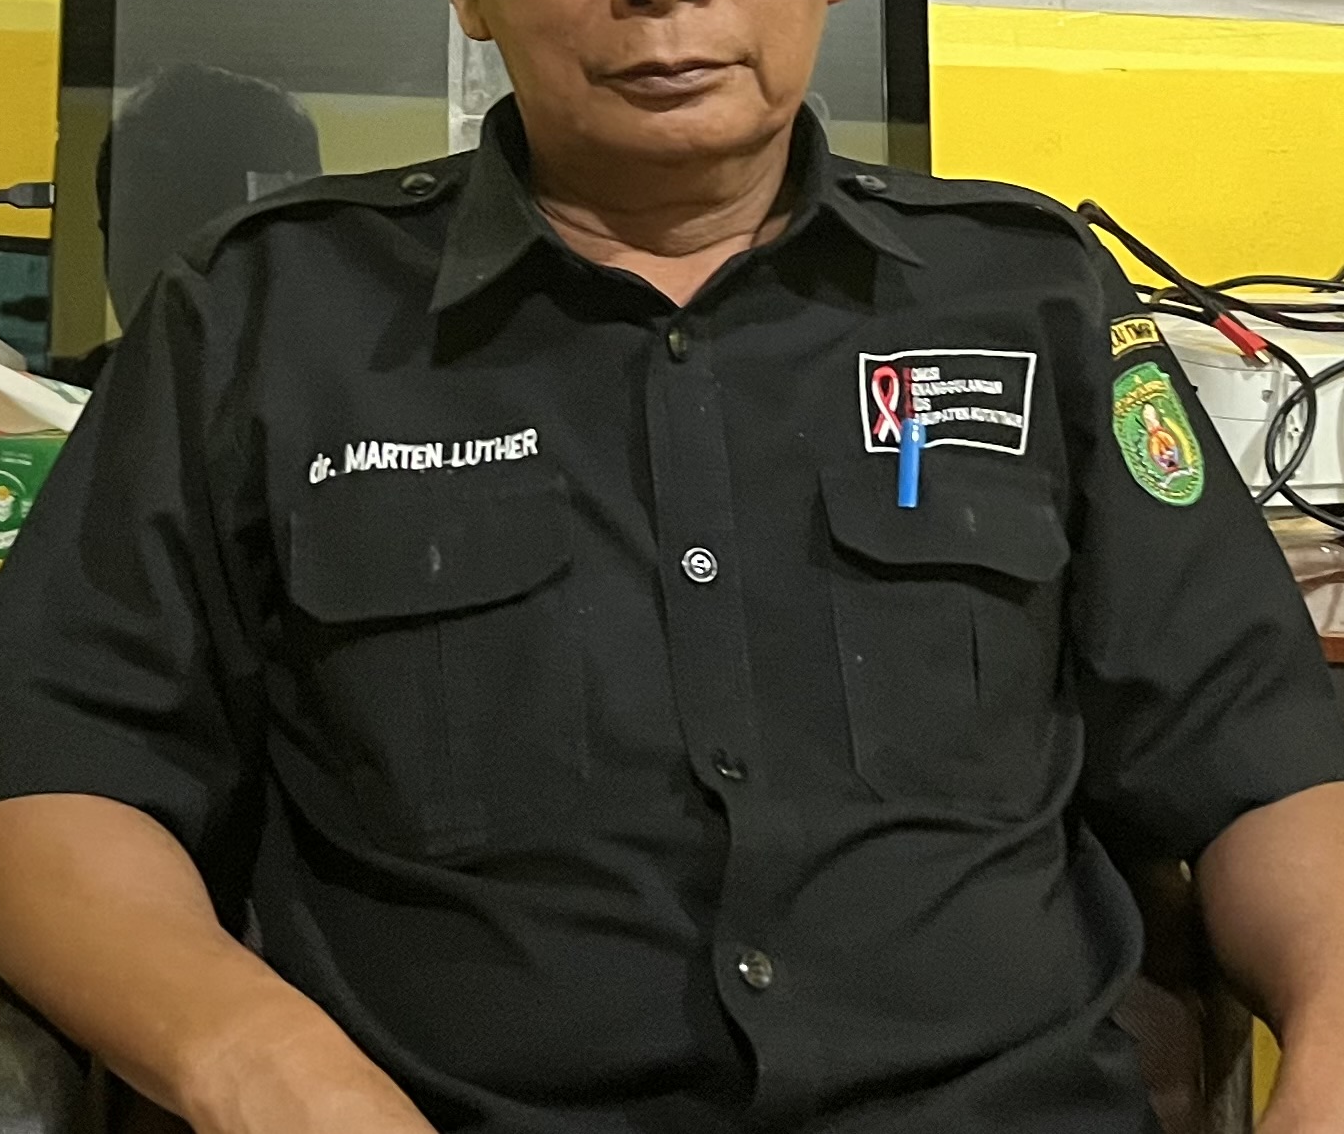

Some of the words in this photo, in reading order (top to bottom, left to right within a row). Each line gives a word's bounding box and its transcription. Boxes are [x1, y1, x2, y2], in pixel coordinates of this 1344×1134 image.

[309, 452, 337, 484] dr.
[345, 440, 444, 474] MARTEN
[451, 427, 539, 468] LUTHER
